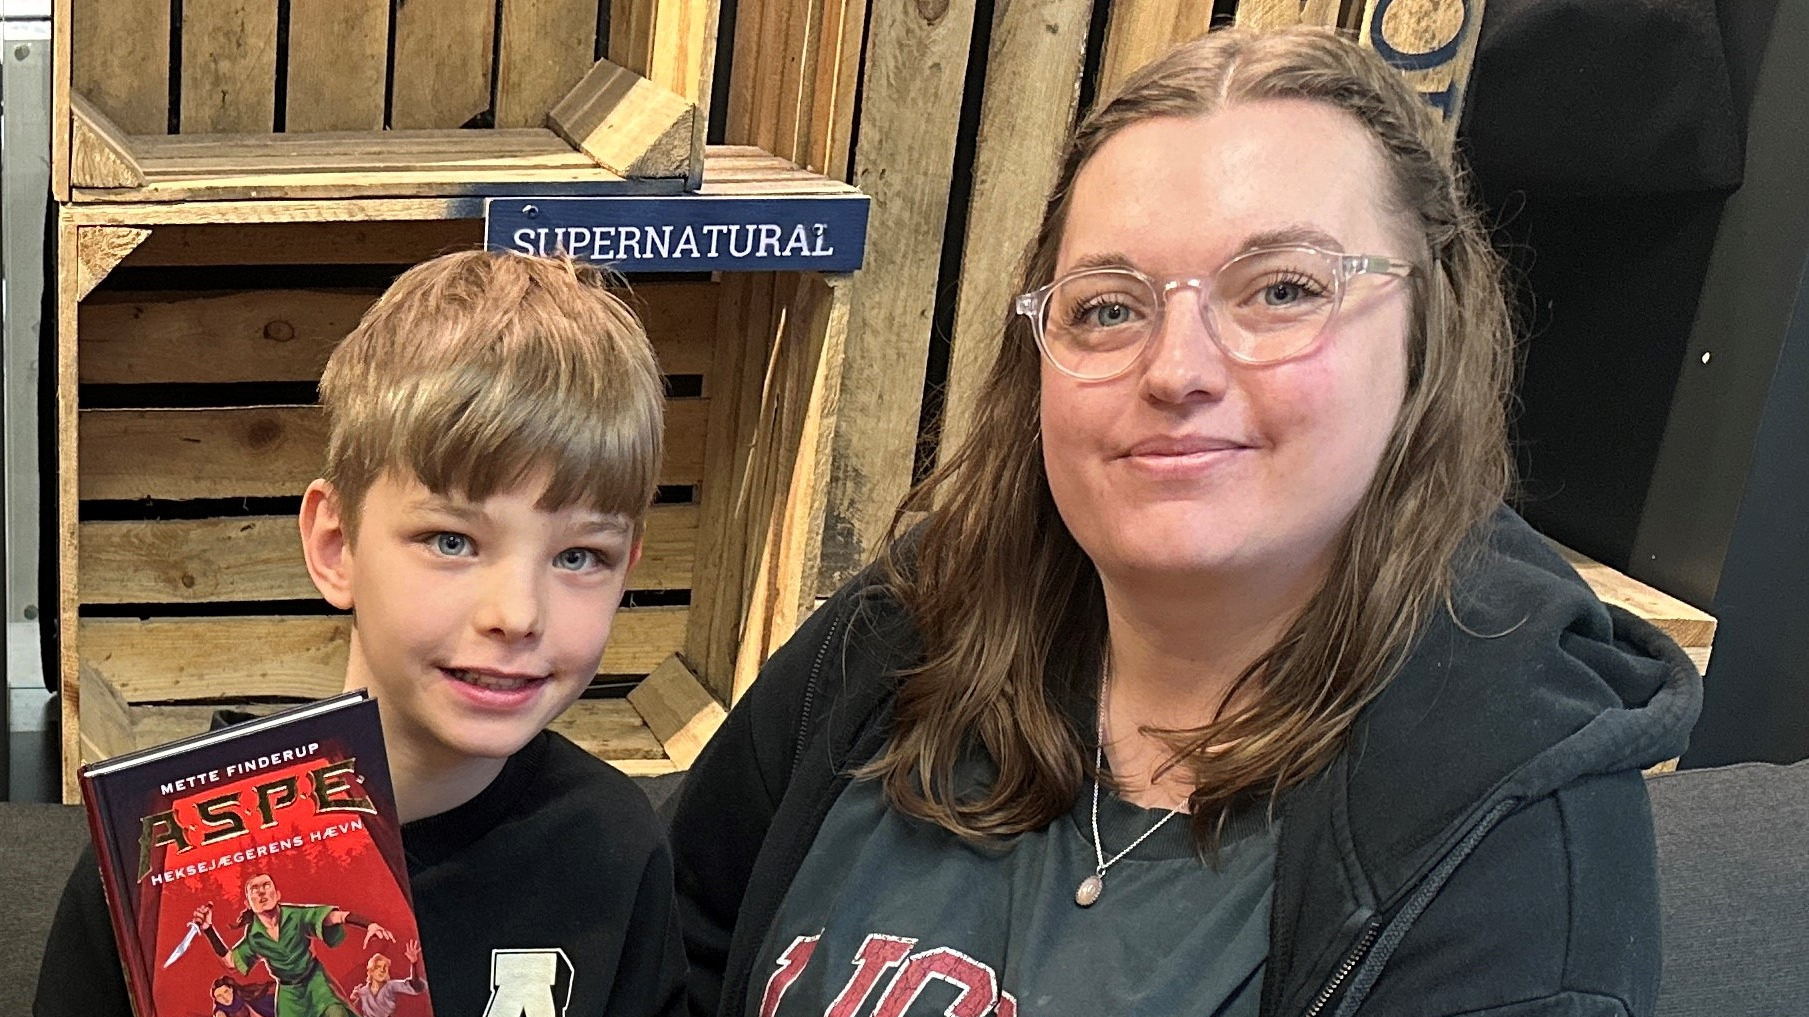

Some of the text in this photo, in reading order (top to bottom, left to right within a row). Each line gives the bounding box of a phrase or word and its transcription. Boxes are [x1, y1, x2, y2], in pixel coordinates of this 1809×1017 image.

[513, 223, 834, 261] SUPERNATURAL
[160, 742, 320, 796] METTE FINDERUP
[137, 757, 379, 885] ASPE
[151, 834, 304, 887] HEKSEJÆGERENS
[309, 818, 364, 843] HÆVN
